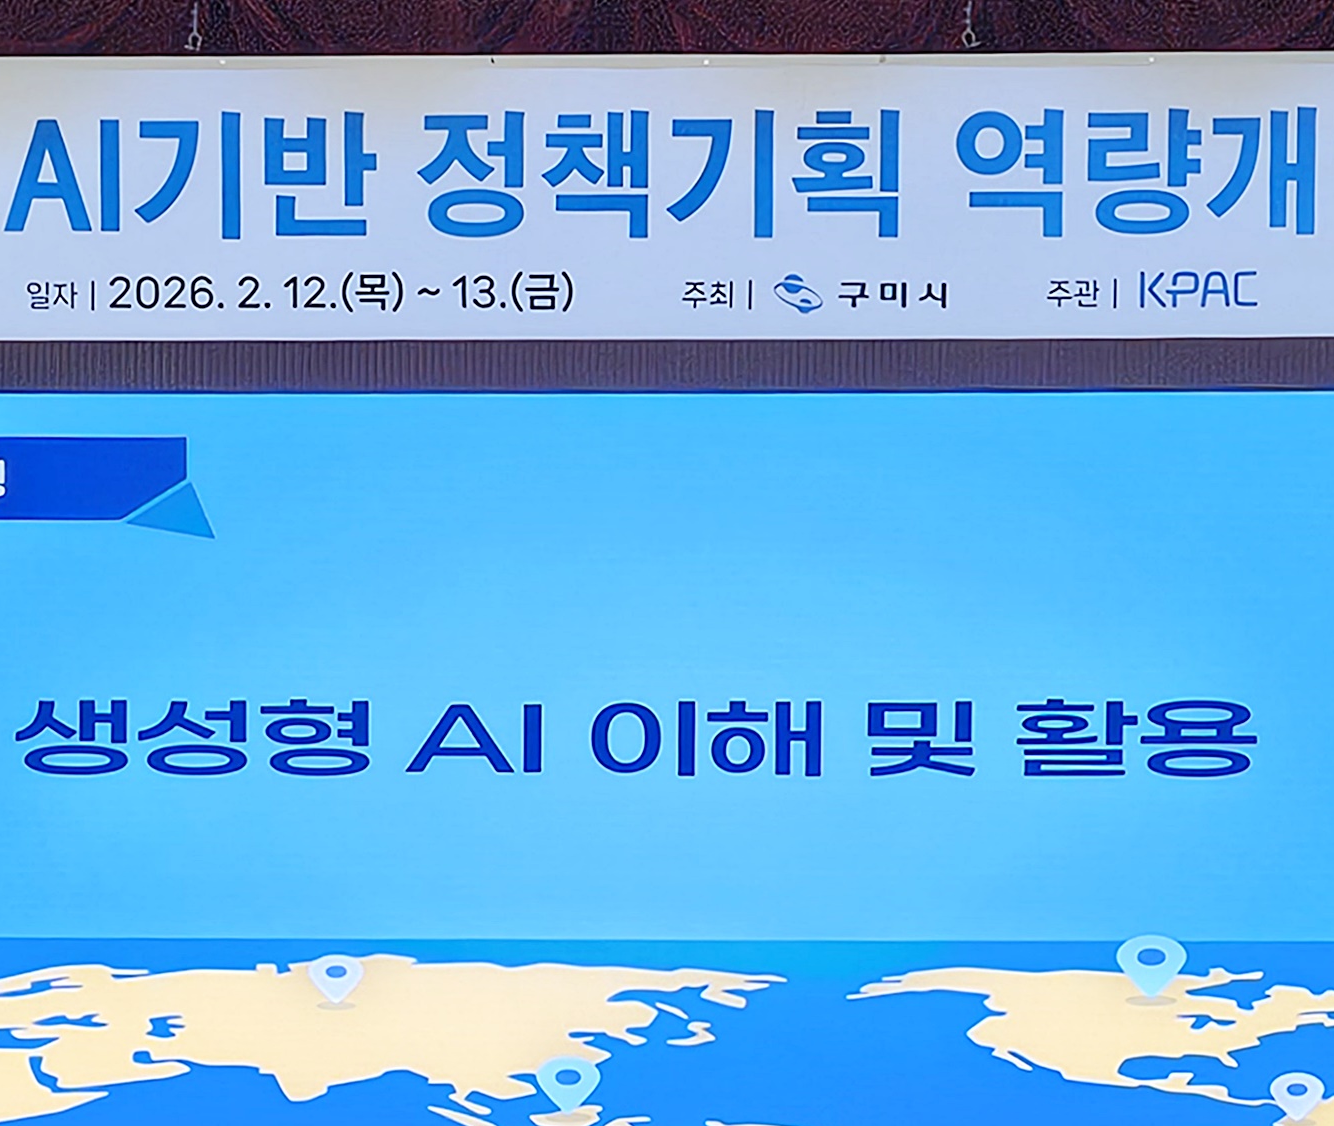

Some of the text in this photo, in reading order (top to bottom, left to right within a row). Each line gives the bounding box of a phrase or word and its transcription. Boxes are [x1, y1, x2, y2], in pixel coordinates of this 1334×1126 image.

[3, 110, 378, 240] AI기반
[416, 109, 900, 239] 정책기획
[26, 280, 78, 310] 일자
[109, 275, 225, 310] 2026.
[237, 275, 271, 310] 2.
[283, 271, 404, 313] 12.(목)
[452, 271, 575, 313] 13.(금)
[681, 280, 948, 309] 주최 구미시
[1046, 270, 1258, 309] 주관 KPAC
[14, 698, 1259, 778] 생성형 AI 이해 및 활용
